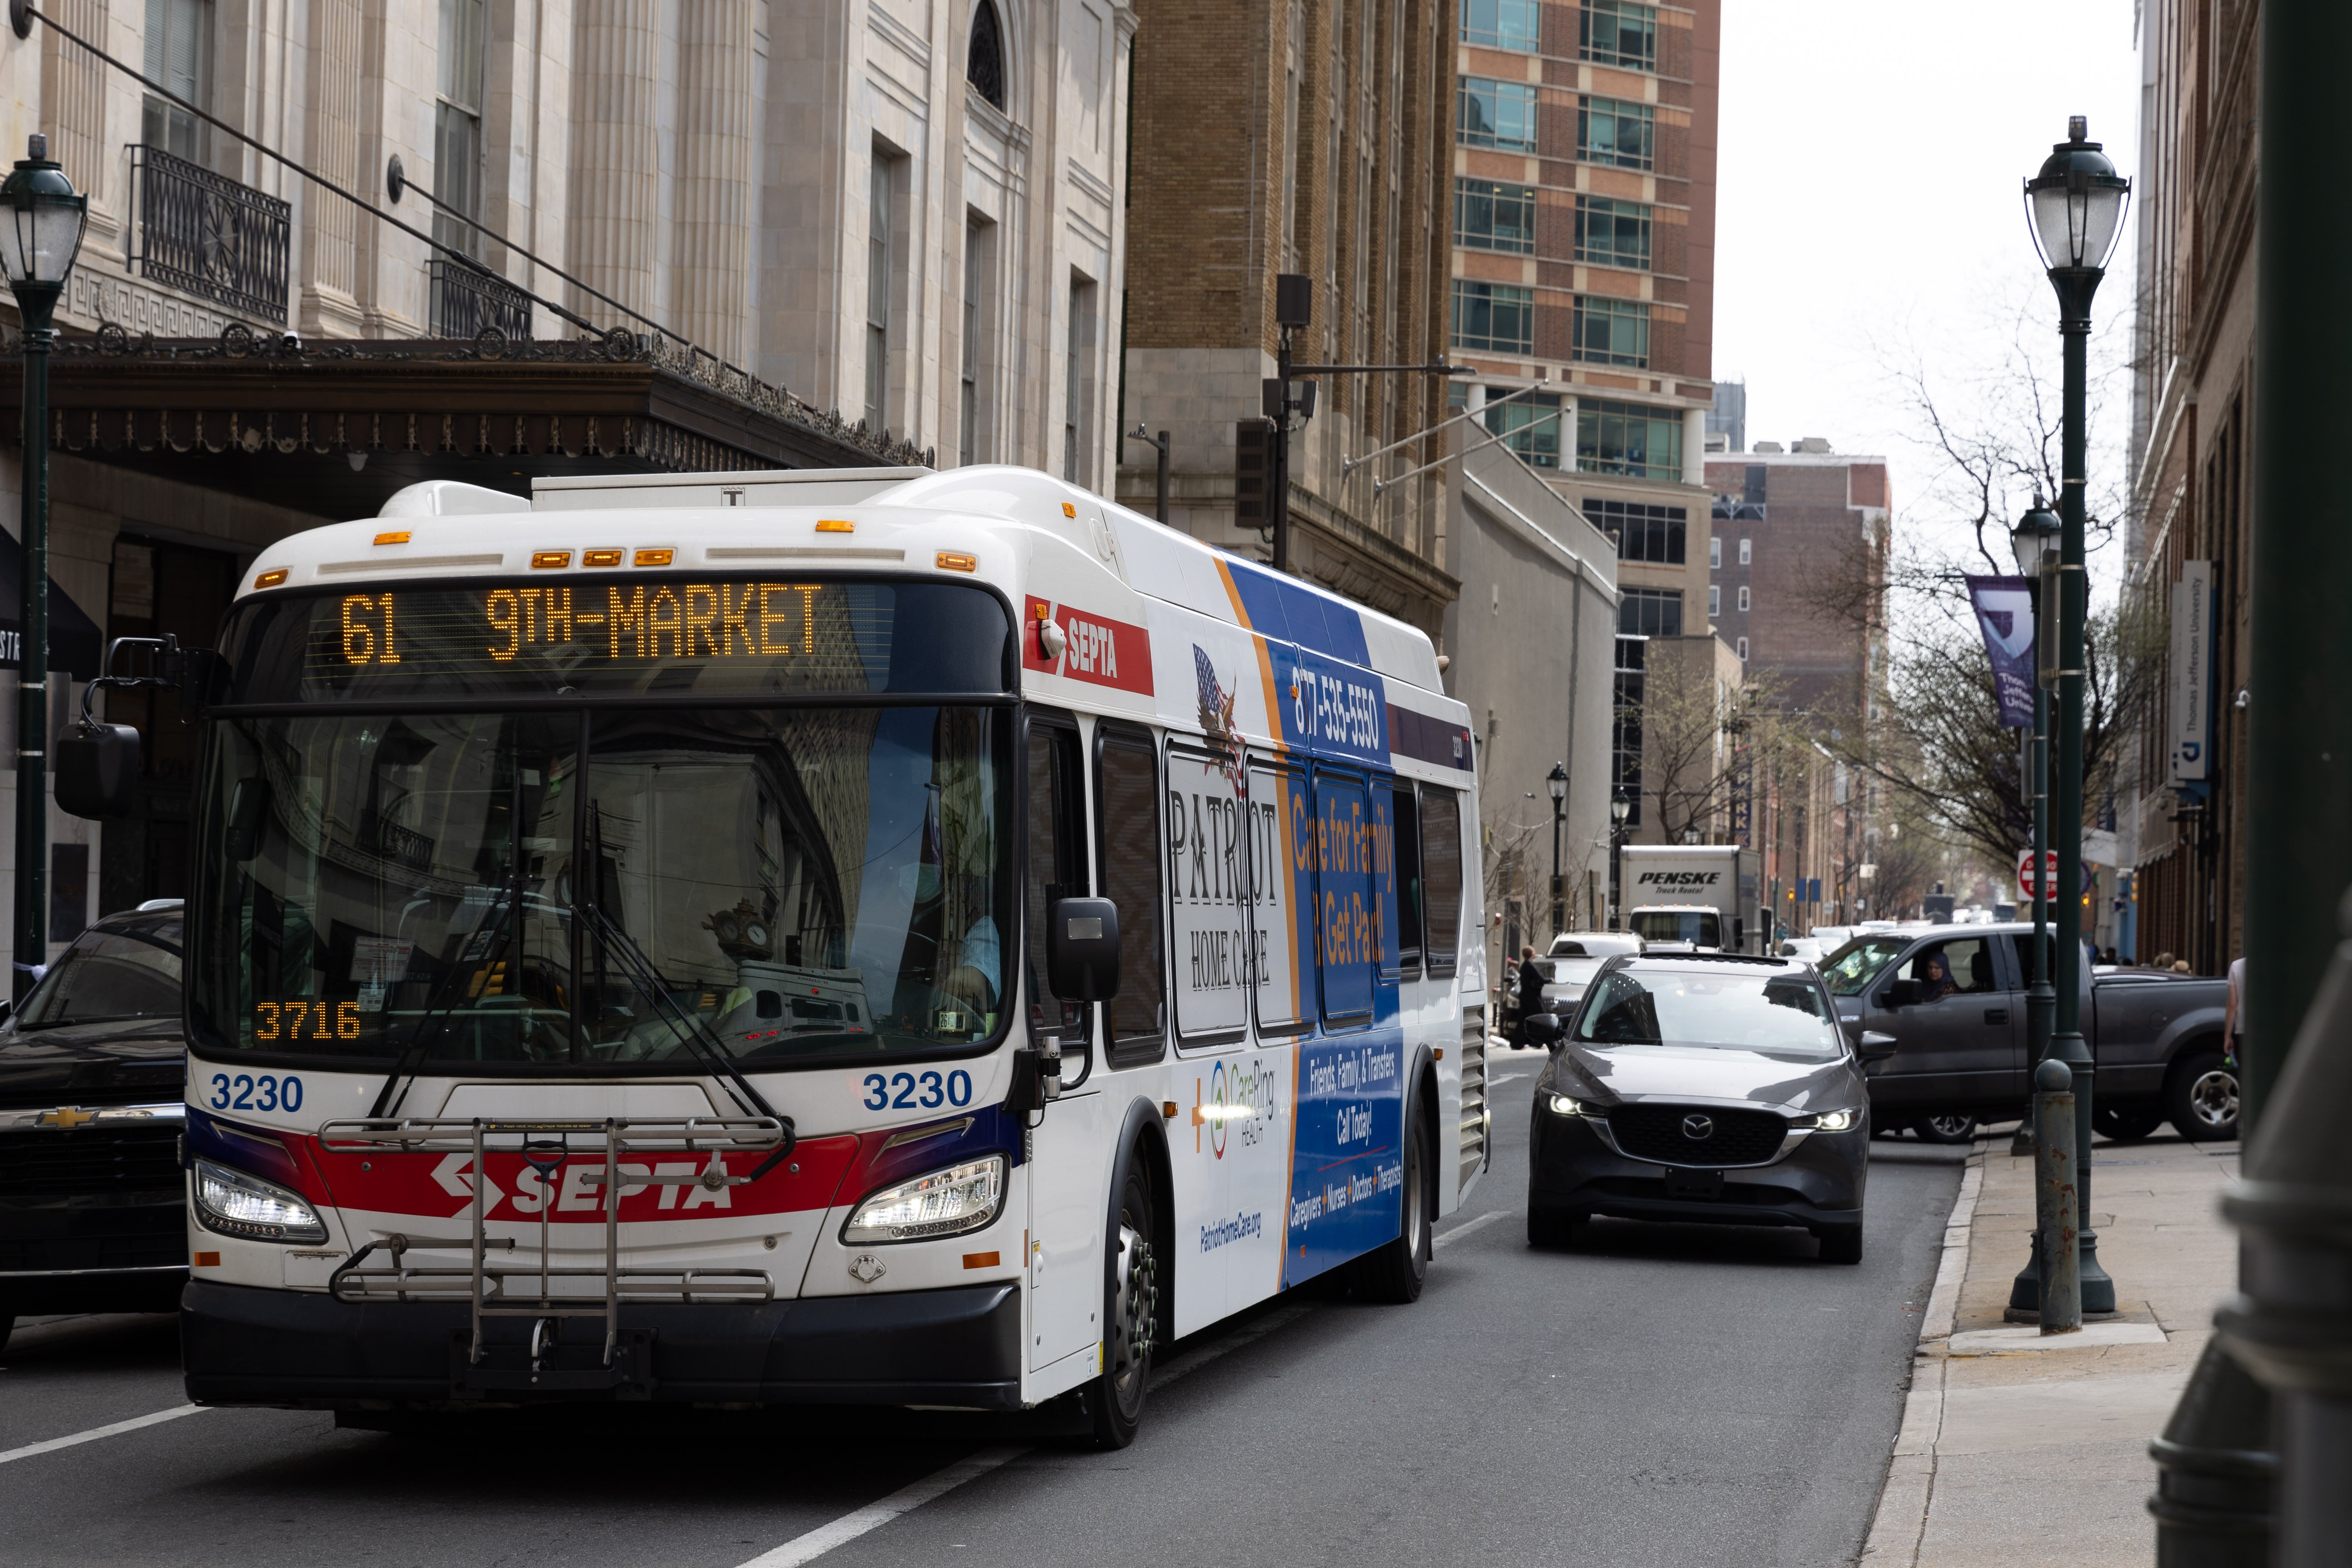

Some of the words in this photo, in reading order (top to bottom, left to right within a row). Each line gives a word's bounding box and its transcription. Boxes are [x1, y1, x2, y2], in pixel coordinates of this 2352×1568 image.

[343, 593, 400, 664] 61
[487, 583, 822, 661] 9TH-MARKET
[2190, 576, 2203, 633] University
[0, 630, 20, 661] STR
[1068, 617, 1117, 679] SEPTA
[2188, 635, 2200, 687] Jefferson
[1999, 672, 2027, 690] Thom
[1292, 666, 1379, 750] 877-535-5550
[2004, 696, 2034, 714] Univer
[2187, 689, 2199, 733] Thomas
[1452, 735, 1462, 759] 3230
[1330, 797, 1349, 873] for
[1352, 802, 1392, 893] Family
[1638, 872, 1720, 884] PENSKE
[2029, 882, 2057, 892] EER
[1326, 890, 1352, 965] Get
[1191, 931, 1230, 991] HOME
[257, 1001, 360, 1039] 3716
[863, 1070, 972, 1111] 3230
[1310, 1057, 1336, 1096] Friends,
[1338, 1050, 1361, 1095] Family,
[1362, 1048, 1367, 1083] &
[1367, 1044, 1394, 1082] Transfers
[211, 1073, 303, 1112] 3230
[1242, 1117, 1263, 1147] HEALTH
[1337, 1107, 1350, 1146] Call
[1352, 1102, 1372, 1146] Today!
[511, 1161, 733, 1213] SEPTA
[1290, 1191, 1321, 1230] Caregivers
[1328, 1182, 1346, 1212] Nurses
[1352, 1174, 1372, 1204] Doctors
[1377, 1159, 1401, 1194] Therapists
[1200, 1211, 1261, 1254] PatriotHomeCare.org
